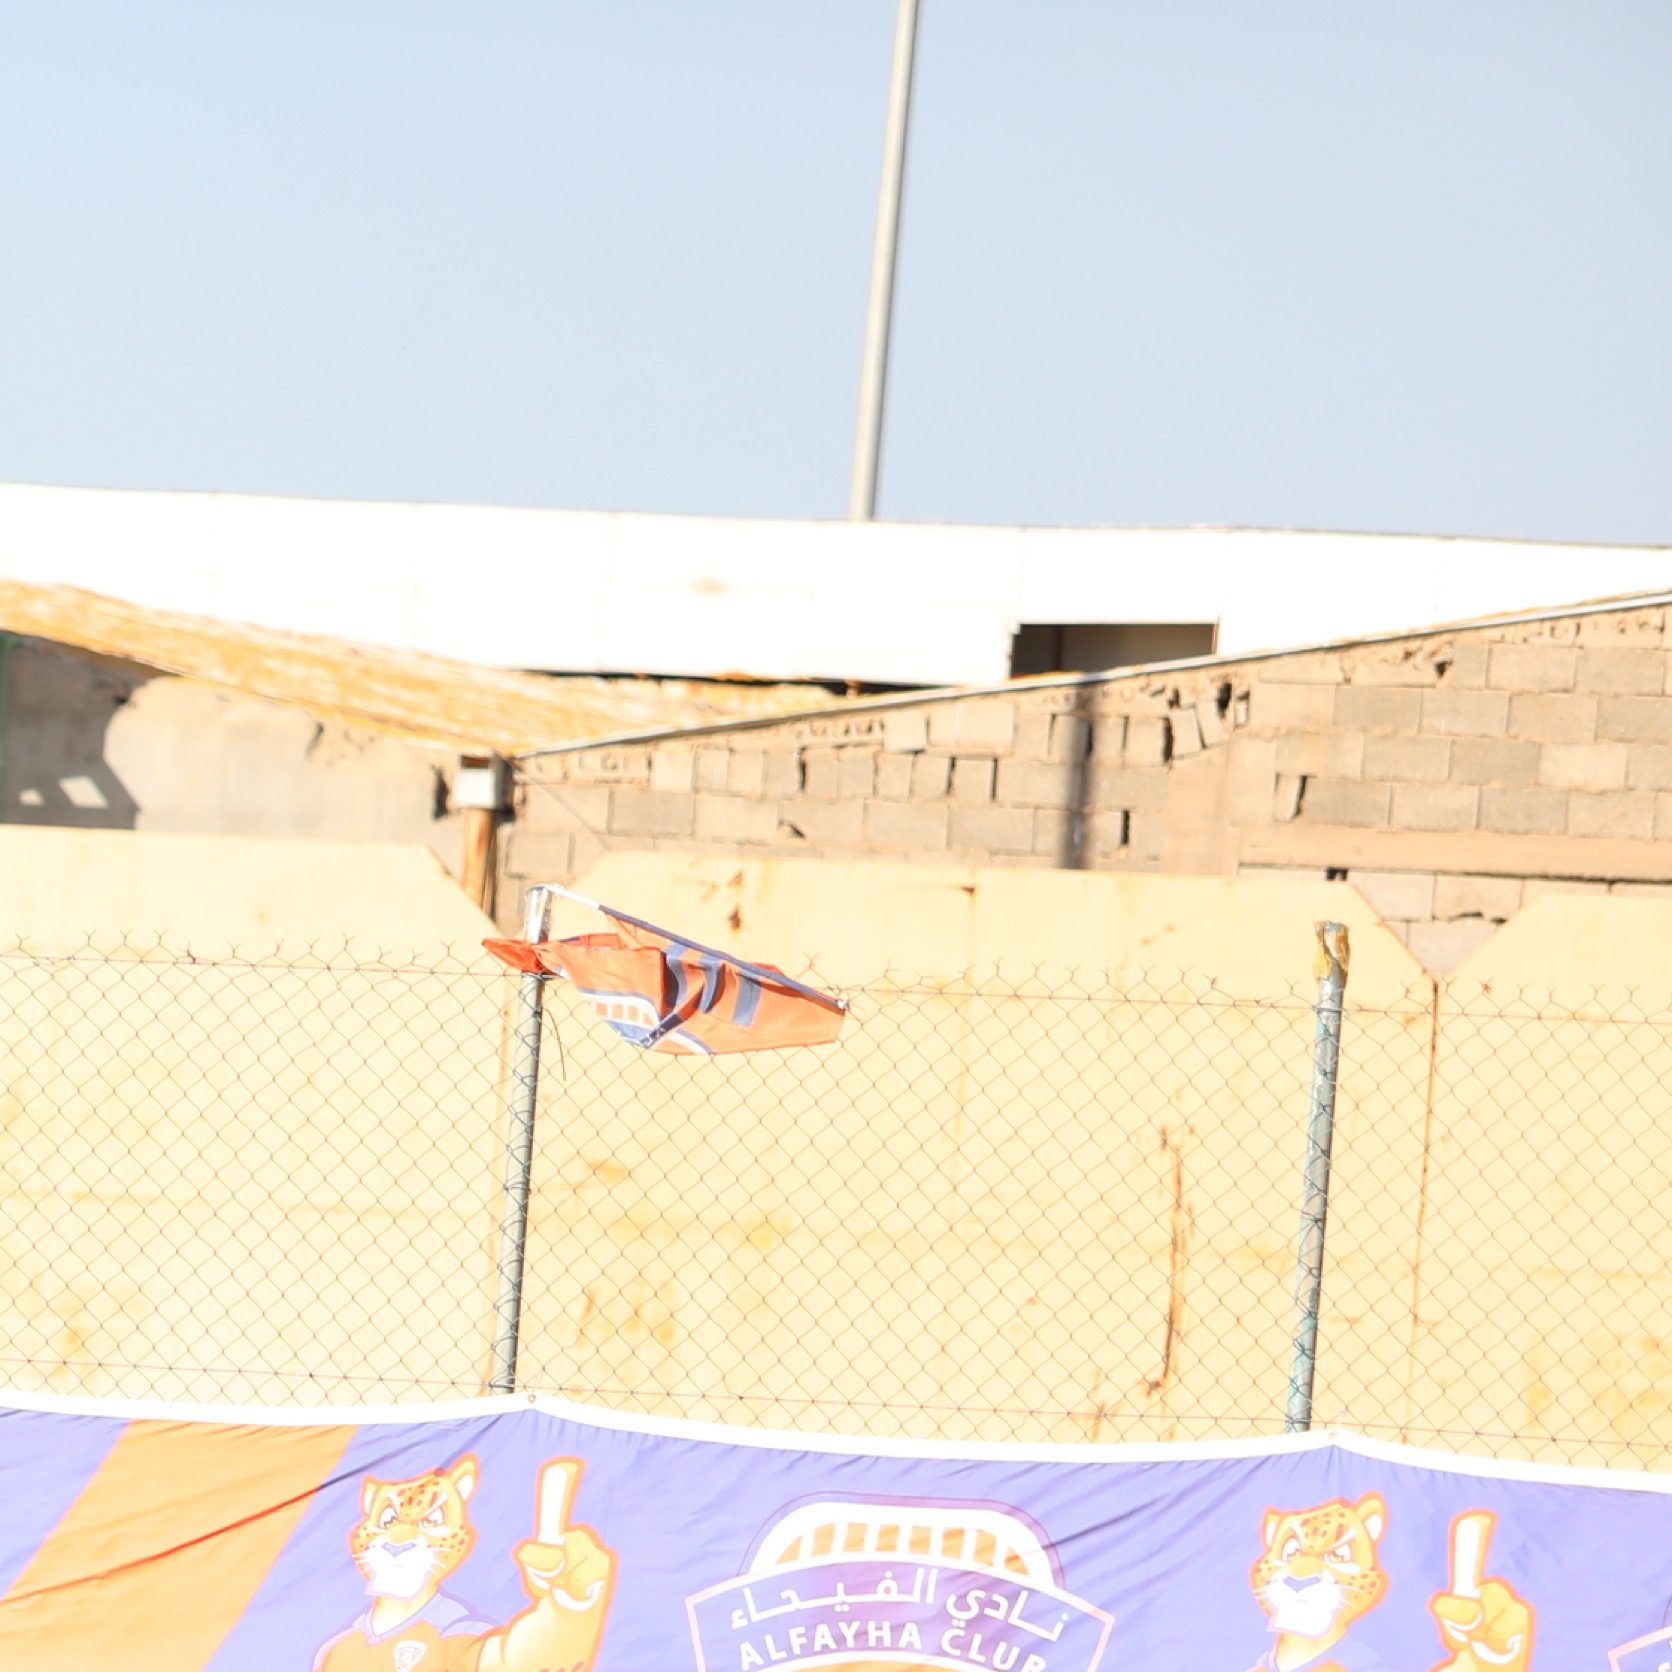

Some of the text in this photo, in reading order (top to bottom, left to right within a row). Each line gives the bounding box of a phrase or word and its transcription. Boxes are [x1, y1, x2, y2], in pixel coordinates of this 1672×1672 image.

[731, 1568, 1069, 1642] نادي الفيحاء
[740, 1622, 923, 1671] ALFAYHA
